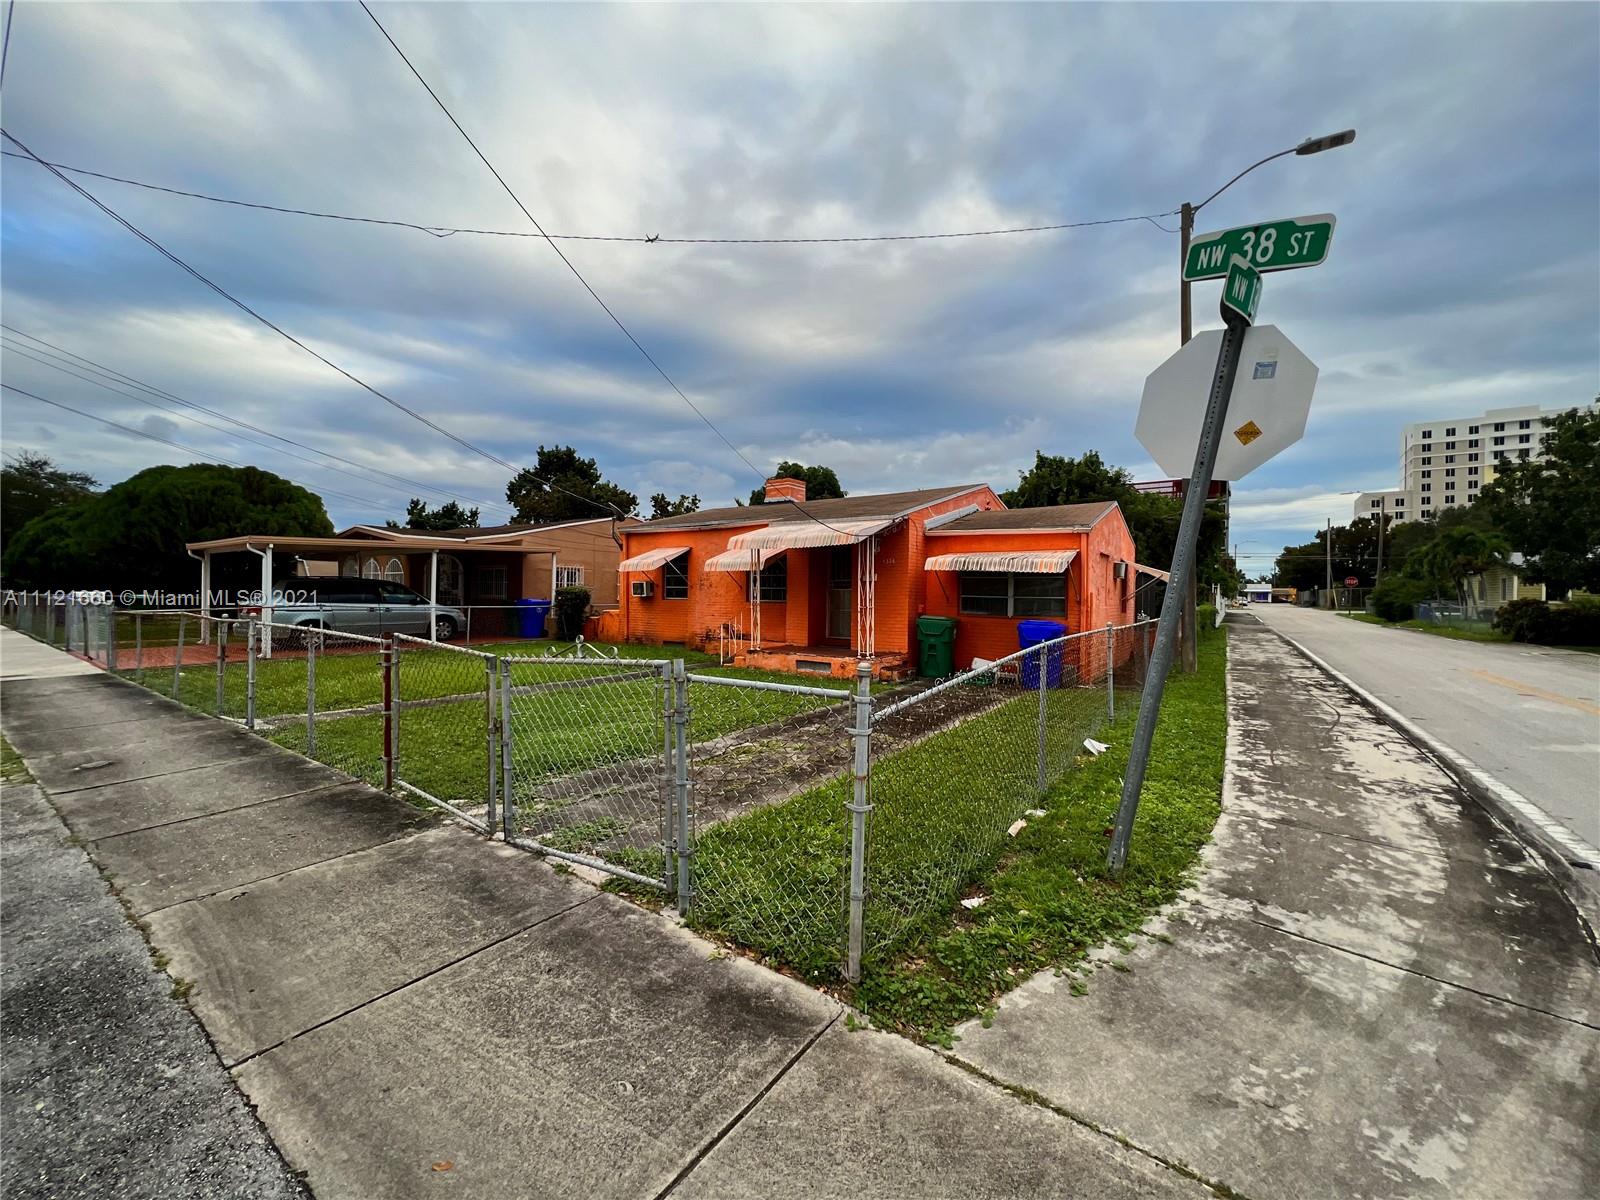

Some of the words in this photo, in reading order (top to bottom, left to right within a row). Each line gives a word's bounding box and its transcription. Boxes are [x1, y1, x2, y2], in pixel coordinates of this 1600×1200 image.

[1197, 244, 1227, 270] NW
[1241, 228, 1277, 263] 38
[1287, 231, 1315, 257] ST
[1232, 273, 1248, 302] NW
